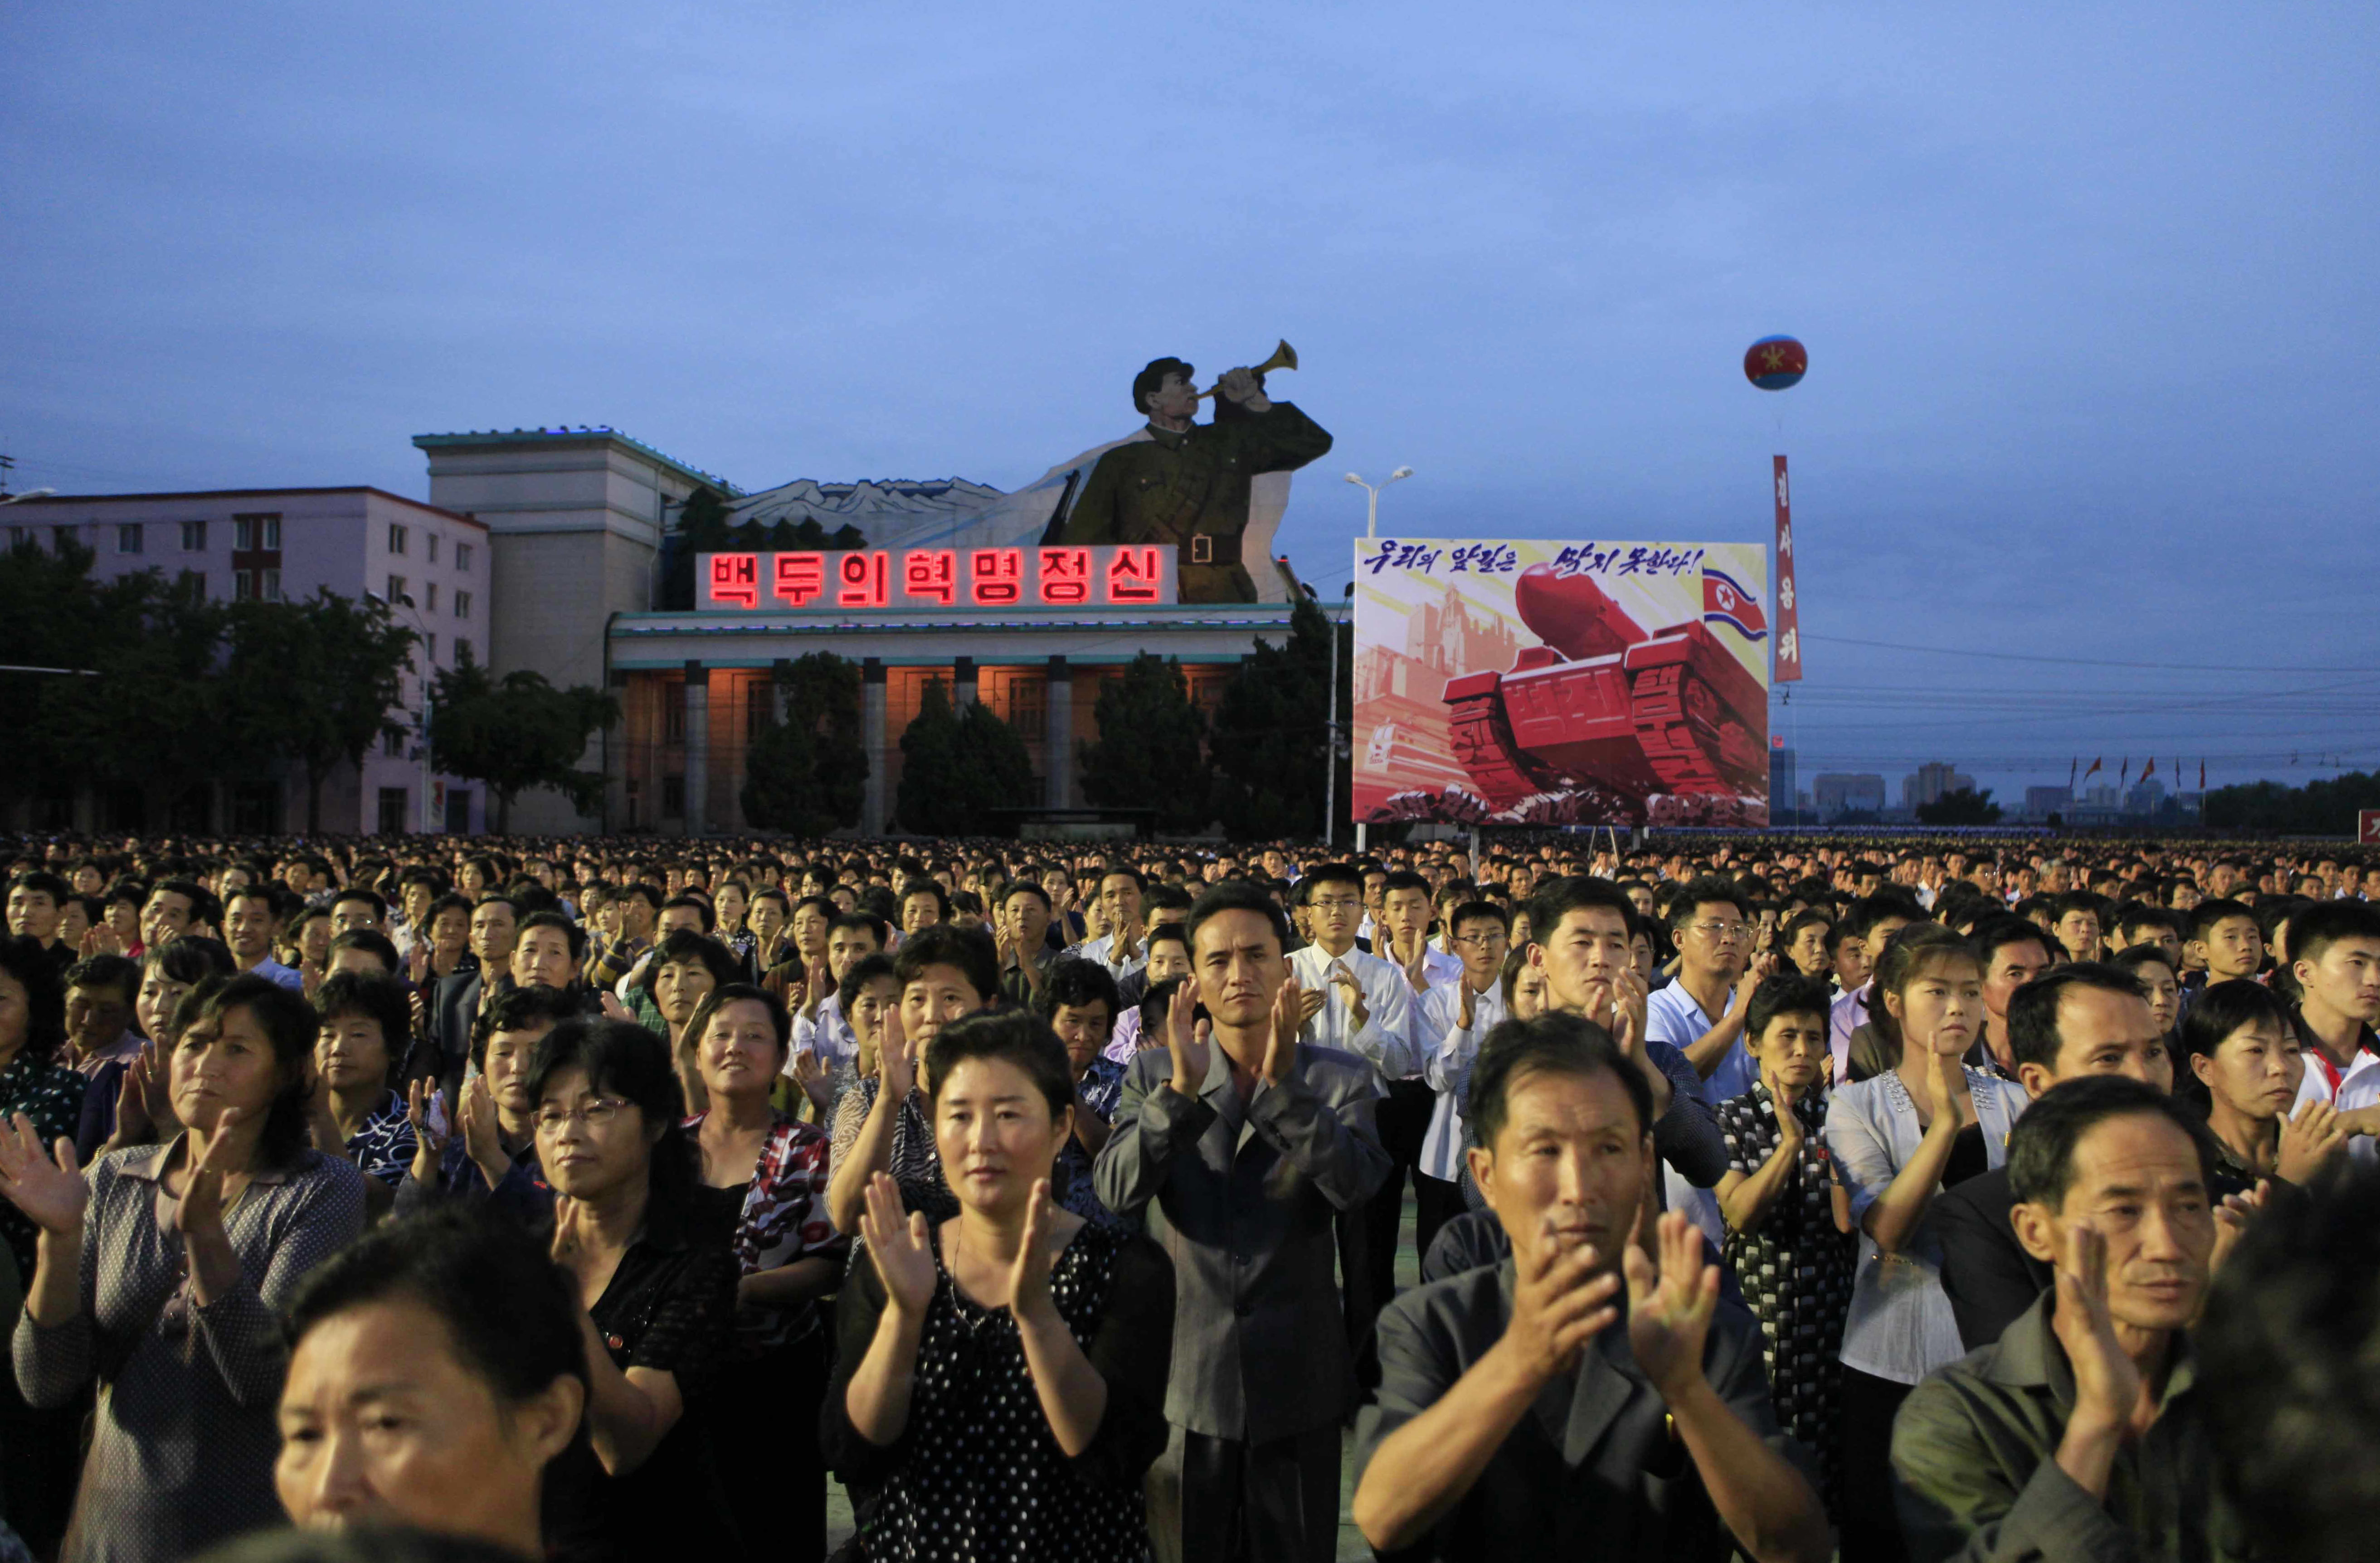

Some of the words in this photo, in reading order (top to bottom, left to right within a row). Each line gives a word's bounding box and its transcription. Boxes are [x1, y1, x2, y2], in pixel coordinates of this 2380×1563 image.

[1364, 539, 1442, 574] 우리의
[1450, 544, 1517, 573] 앞길은
[1776, 471, 1799, 665] 결사옹위
